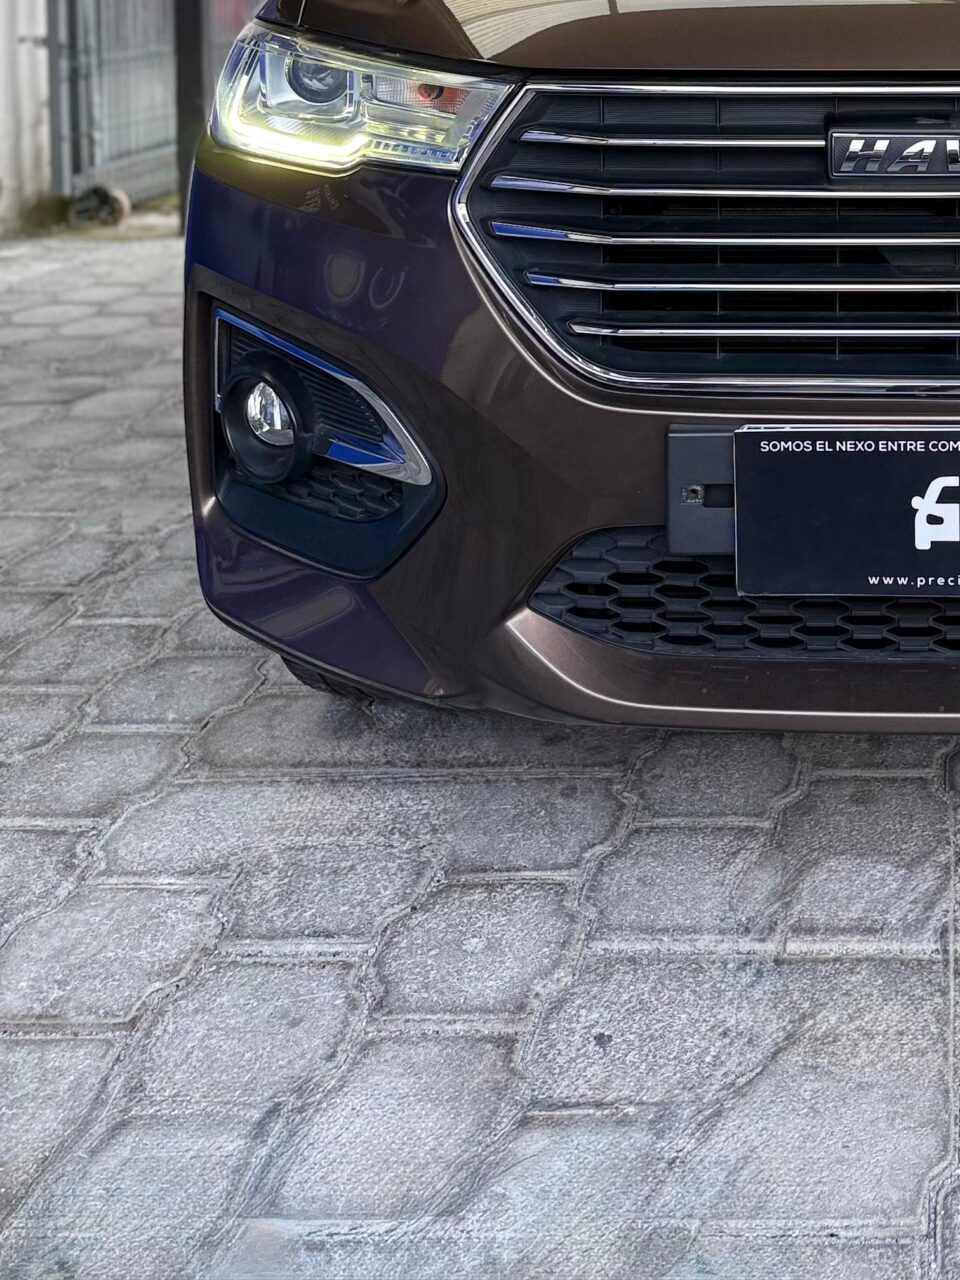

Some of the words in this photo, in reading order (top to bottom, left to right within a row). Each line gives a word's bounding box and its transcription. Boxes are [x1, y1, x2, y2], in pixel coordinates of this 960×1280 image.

[760, 440, 813, 453] SOMOS
[815, 440, 834, 452] EL
[835, 440, 876, 452] NEXO
[878, 440, 926, 452] ENTRE
